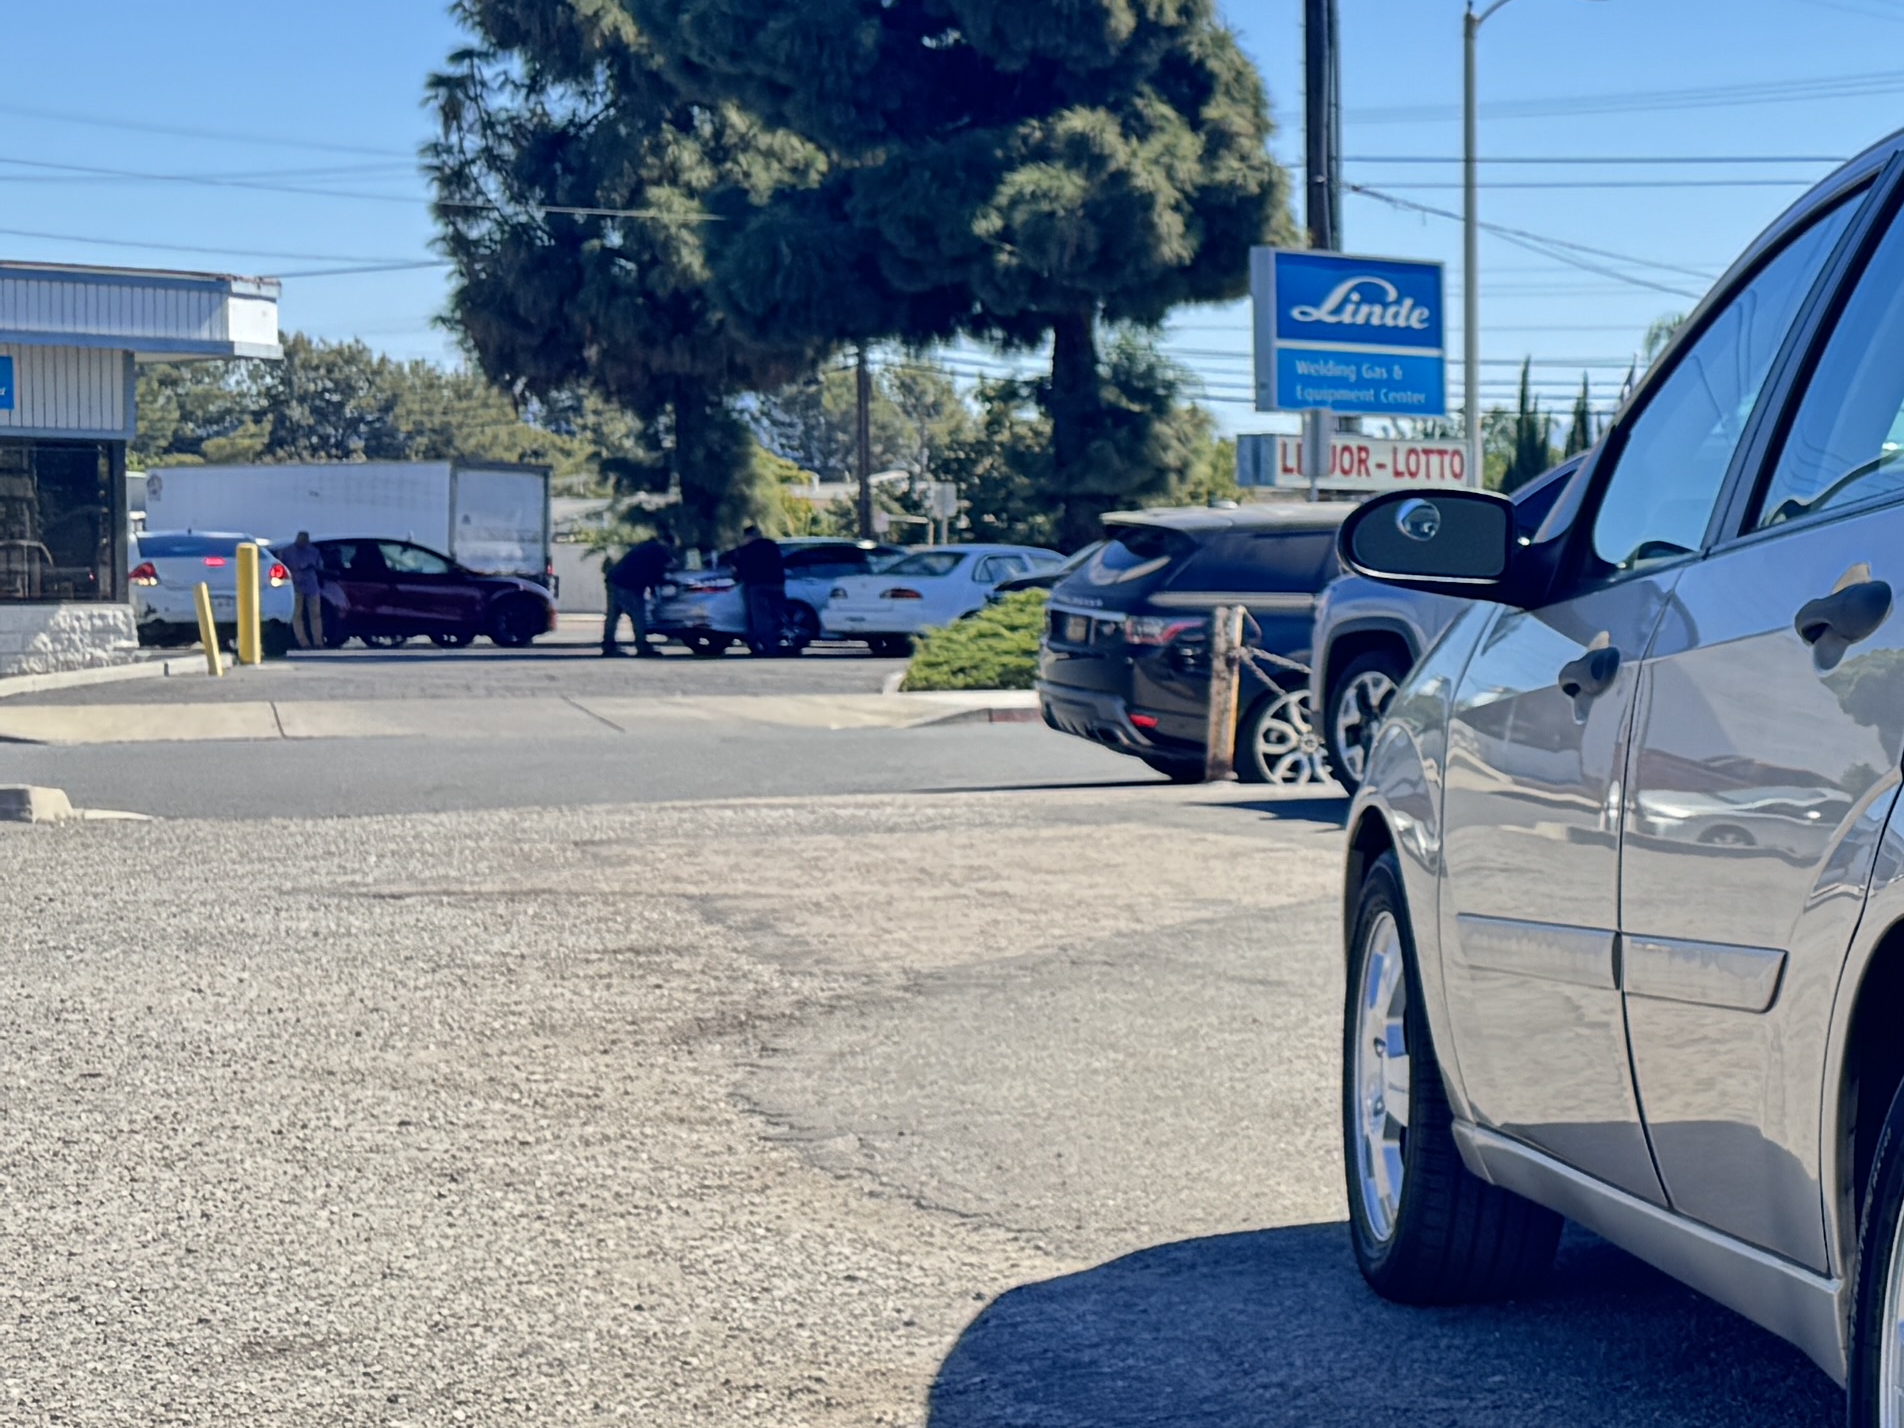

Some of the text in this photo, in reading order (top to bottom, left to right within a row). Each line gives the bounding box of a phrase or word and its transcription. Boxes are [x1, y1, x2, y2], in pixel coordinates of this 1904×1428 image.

[1290, 275, 1431, 330] Linde
[1295, 359, 1357, 383] Welding
[1362, 363, 1388, 380] Gas
[1295, 384, 1427, 405] Equipment Center
[1392, 445, 1466, 480] LOTTO
